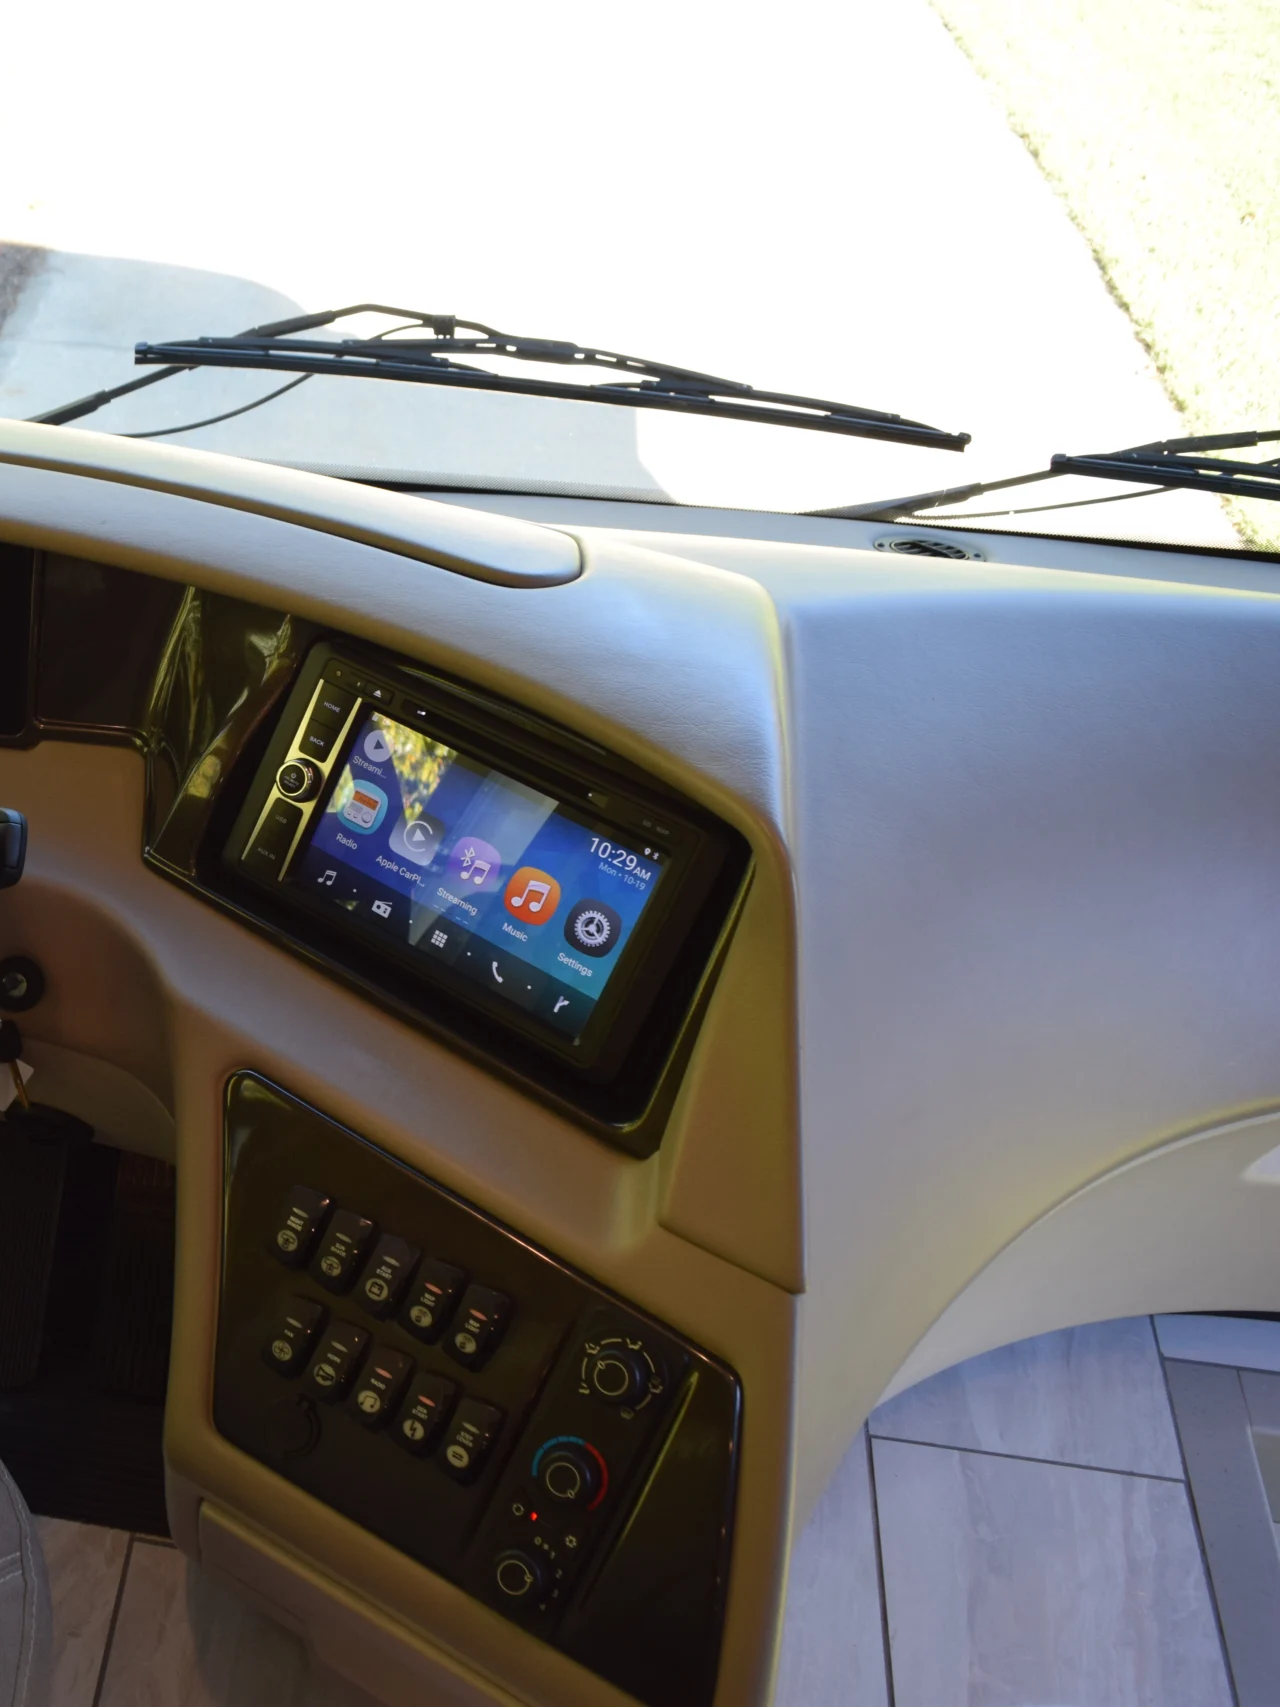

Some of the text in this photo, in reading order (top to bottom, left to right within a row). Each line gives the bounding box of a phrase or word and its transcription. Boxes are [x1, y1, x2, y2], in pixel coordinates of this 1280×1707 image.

[323, 701, 341, 713] HOME
[309, 735, 325, 748] BACK
[275, 814, 287, 824] USB
[336, 832, 358, 850] Radio
[376, 855, 399, 873] Apple
[598, 861, 646, 891] Mon 10-19
[436, 886, 478, 916] Streaming
[502, 922, 528, 942] Music
[557, 951, 593, 978] Settings
[334, 1242, 346, 1252] SUN
[376, 1268, 393, 1280] START
[380, 1265, 392, 1275] AUX
[411, 1408, 429, 1420] START
